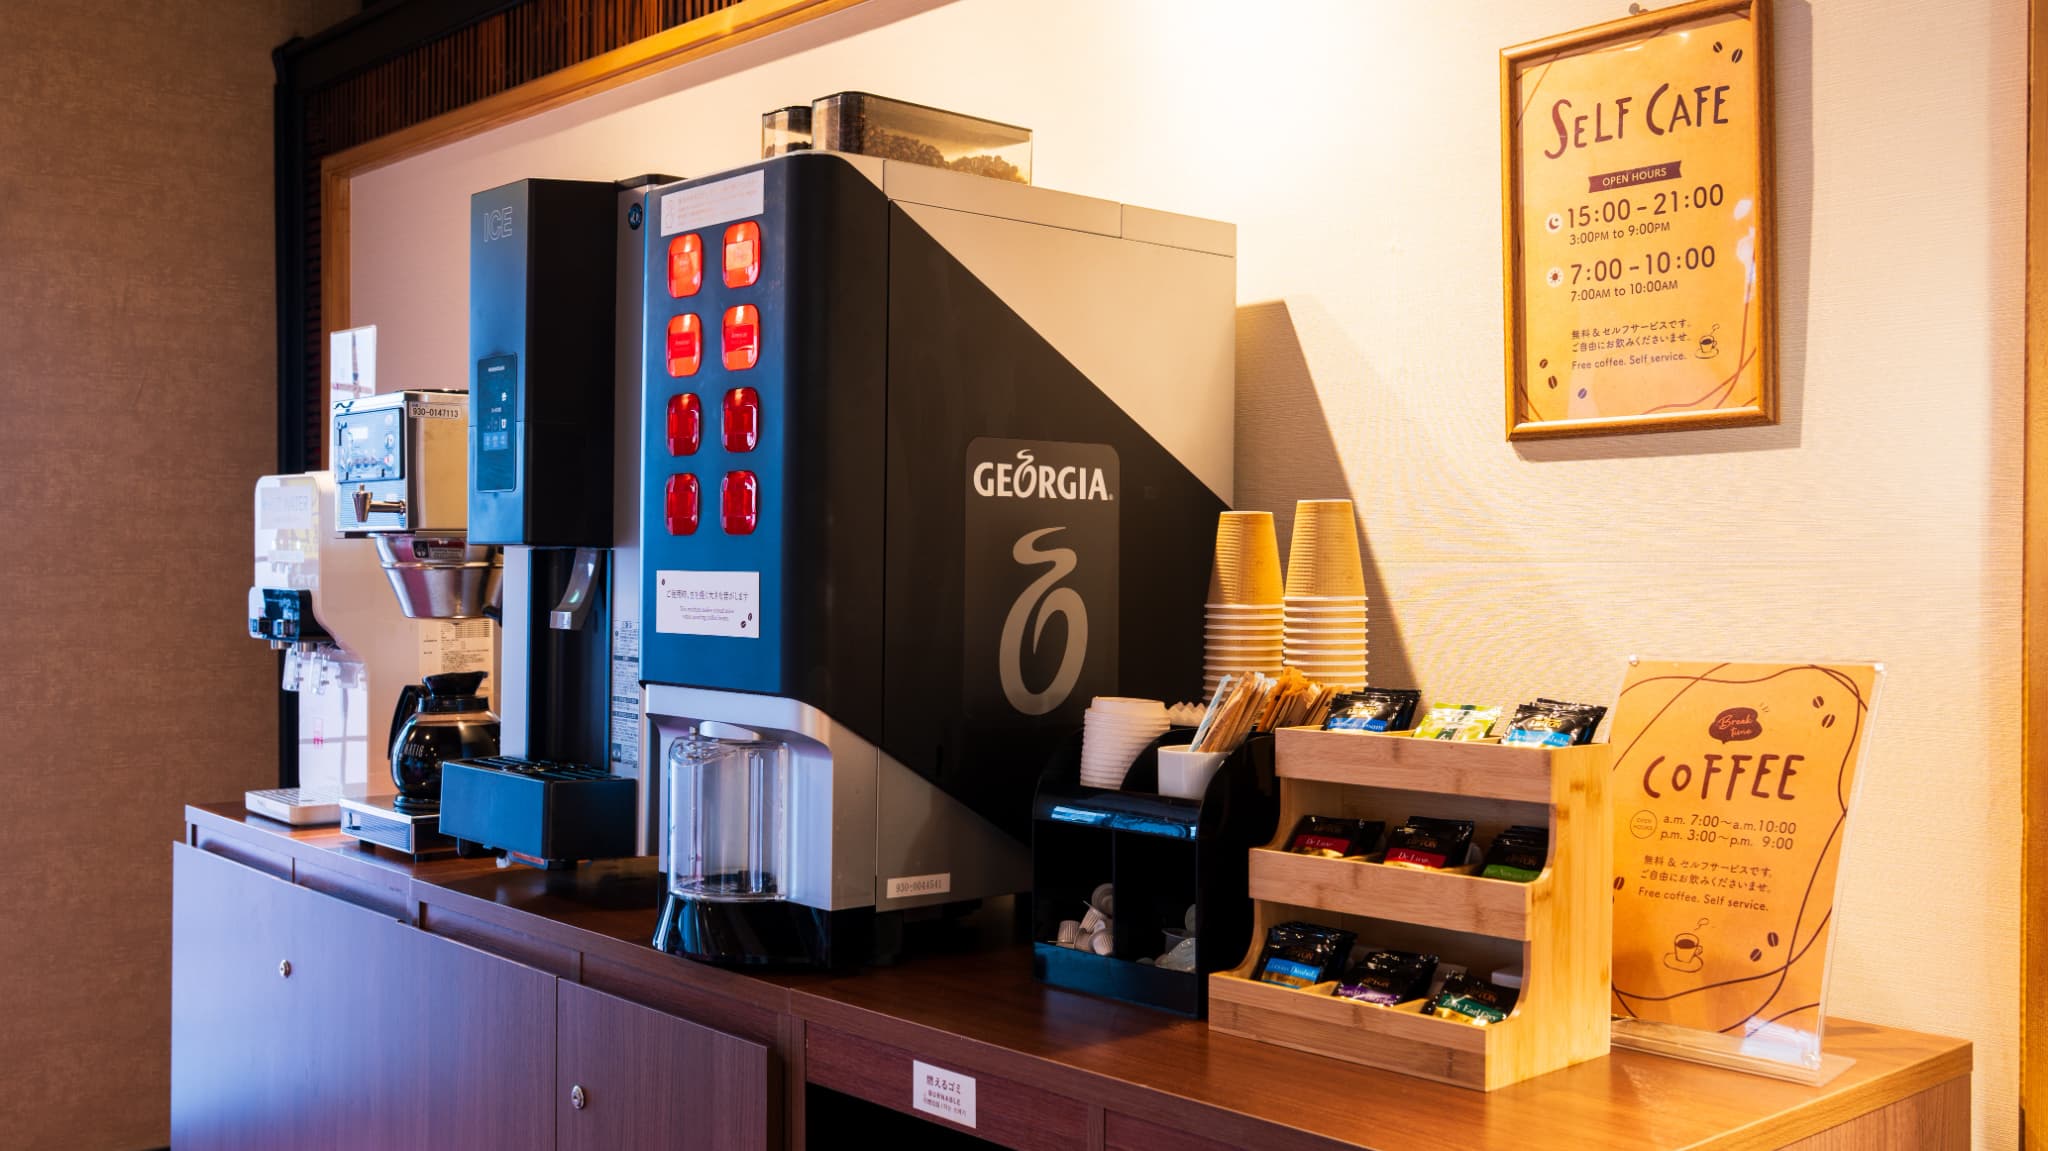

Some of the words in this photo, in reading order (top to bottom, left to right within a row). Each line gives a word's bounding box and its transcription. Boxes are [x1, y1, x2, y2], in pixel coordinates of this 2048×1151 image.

[1544, 96, 1632, 160] SELF
[1645, 83, 1731, 136] CAFE
[1602, 173, 1629, 187] OPEN
[1631, 167, 1667, 182] HOURS
[483, 206, 513, 242] ICE
[1569, 231, 1609, 246] 3:00PM
[1613, 228, 1625, 239] to
[1628, 221, 1671, 237] 9:00PM
[1570, 288, 1611, 303] 7:00AM
[1614, 285, 1626, 297] to
[1630, 279, 1679, 296] 10:00AM
[1571, 360, 1592, 370] Free
[1594, 357, 1627, 369] coffee.
[1629, 354, 1649, 366] Self
[1650, 351, 1688, 364] service.
[973, 449, 1110, 501] GEORGIA
[1638, 886, 1661, 899] Free
[1664, 891, 1700, 904] coffee.
[1703, 894, 1725, 906] Self
[1727, 899, 1769, 912] service.
